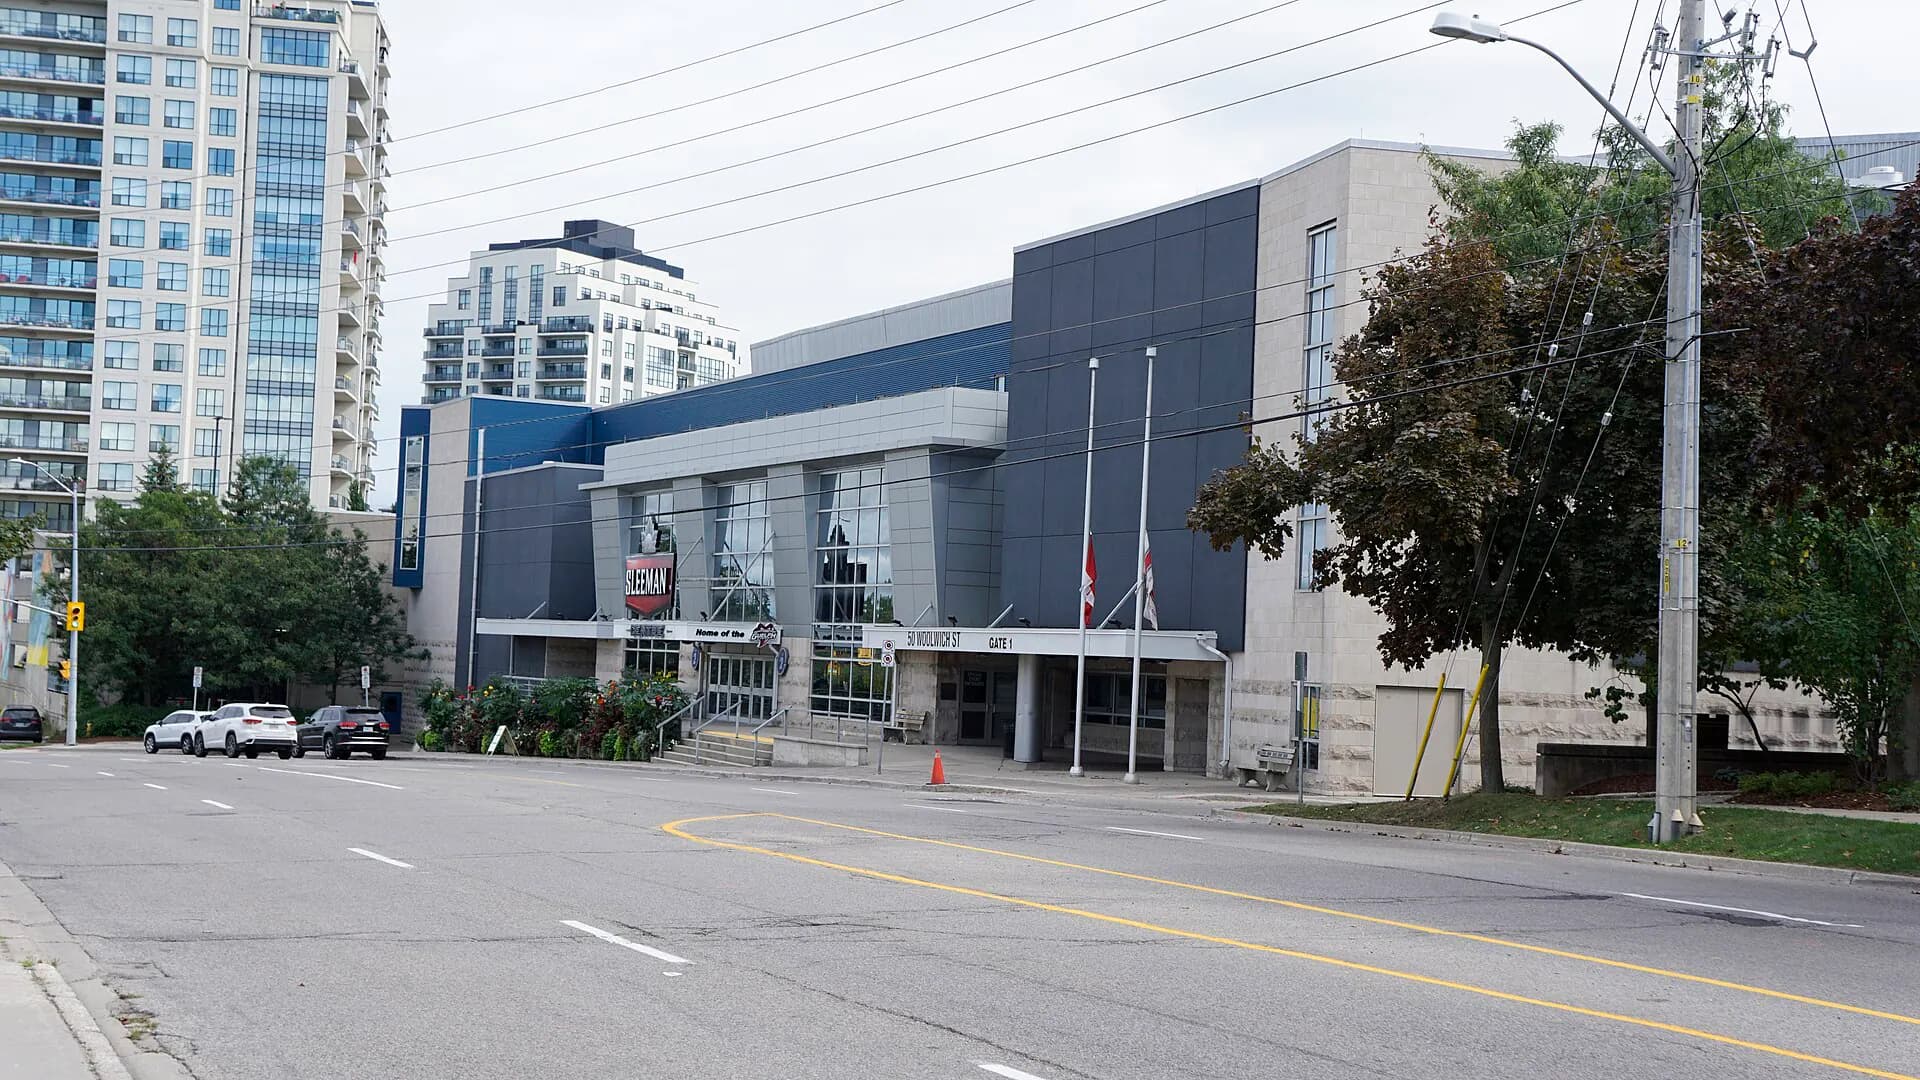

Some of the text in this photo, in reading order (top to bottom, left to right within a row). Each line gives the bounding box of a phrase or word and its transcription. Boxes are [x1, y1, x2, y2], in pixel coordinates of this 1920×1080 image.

[1691, 75, 1699, 83] 10
[1678, 539, 1687, 547] 12
[625, 567, 667, 596] SLEEMAN
[695, 628, 745, 638] Home of the
[907, 631, 961, 648] 50 WOOLWICH ST
[989, 637, 1007, 649] GATE
